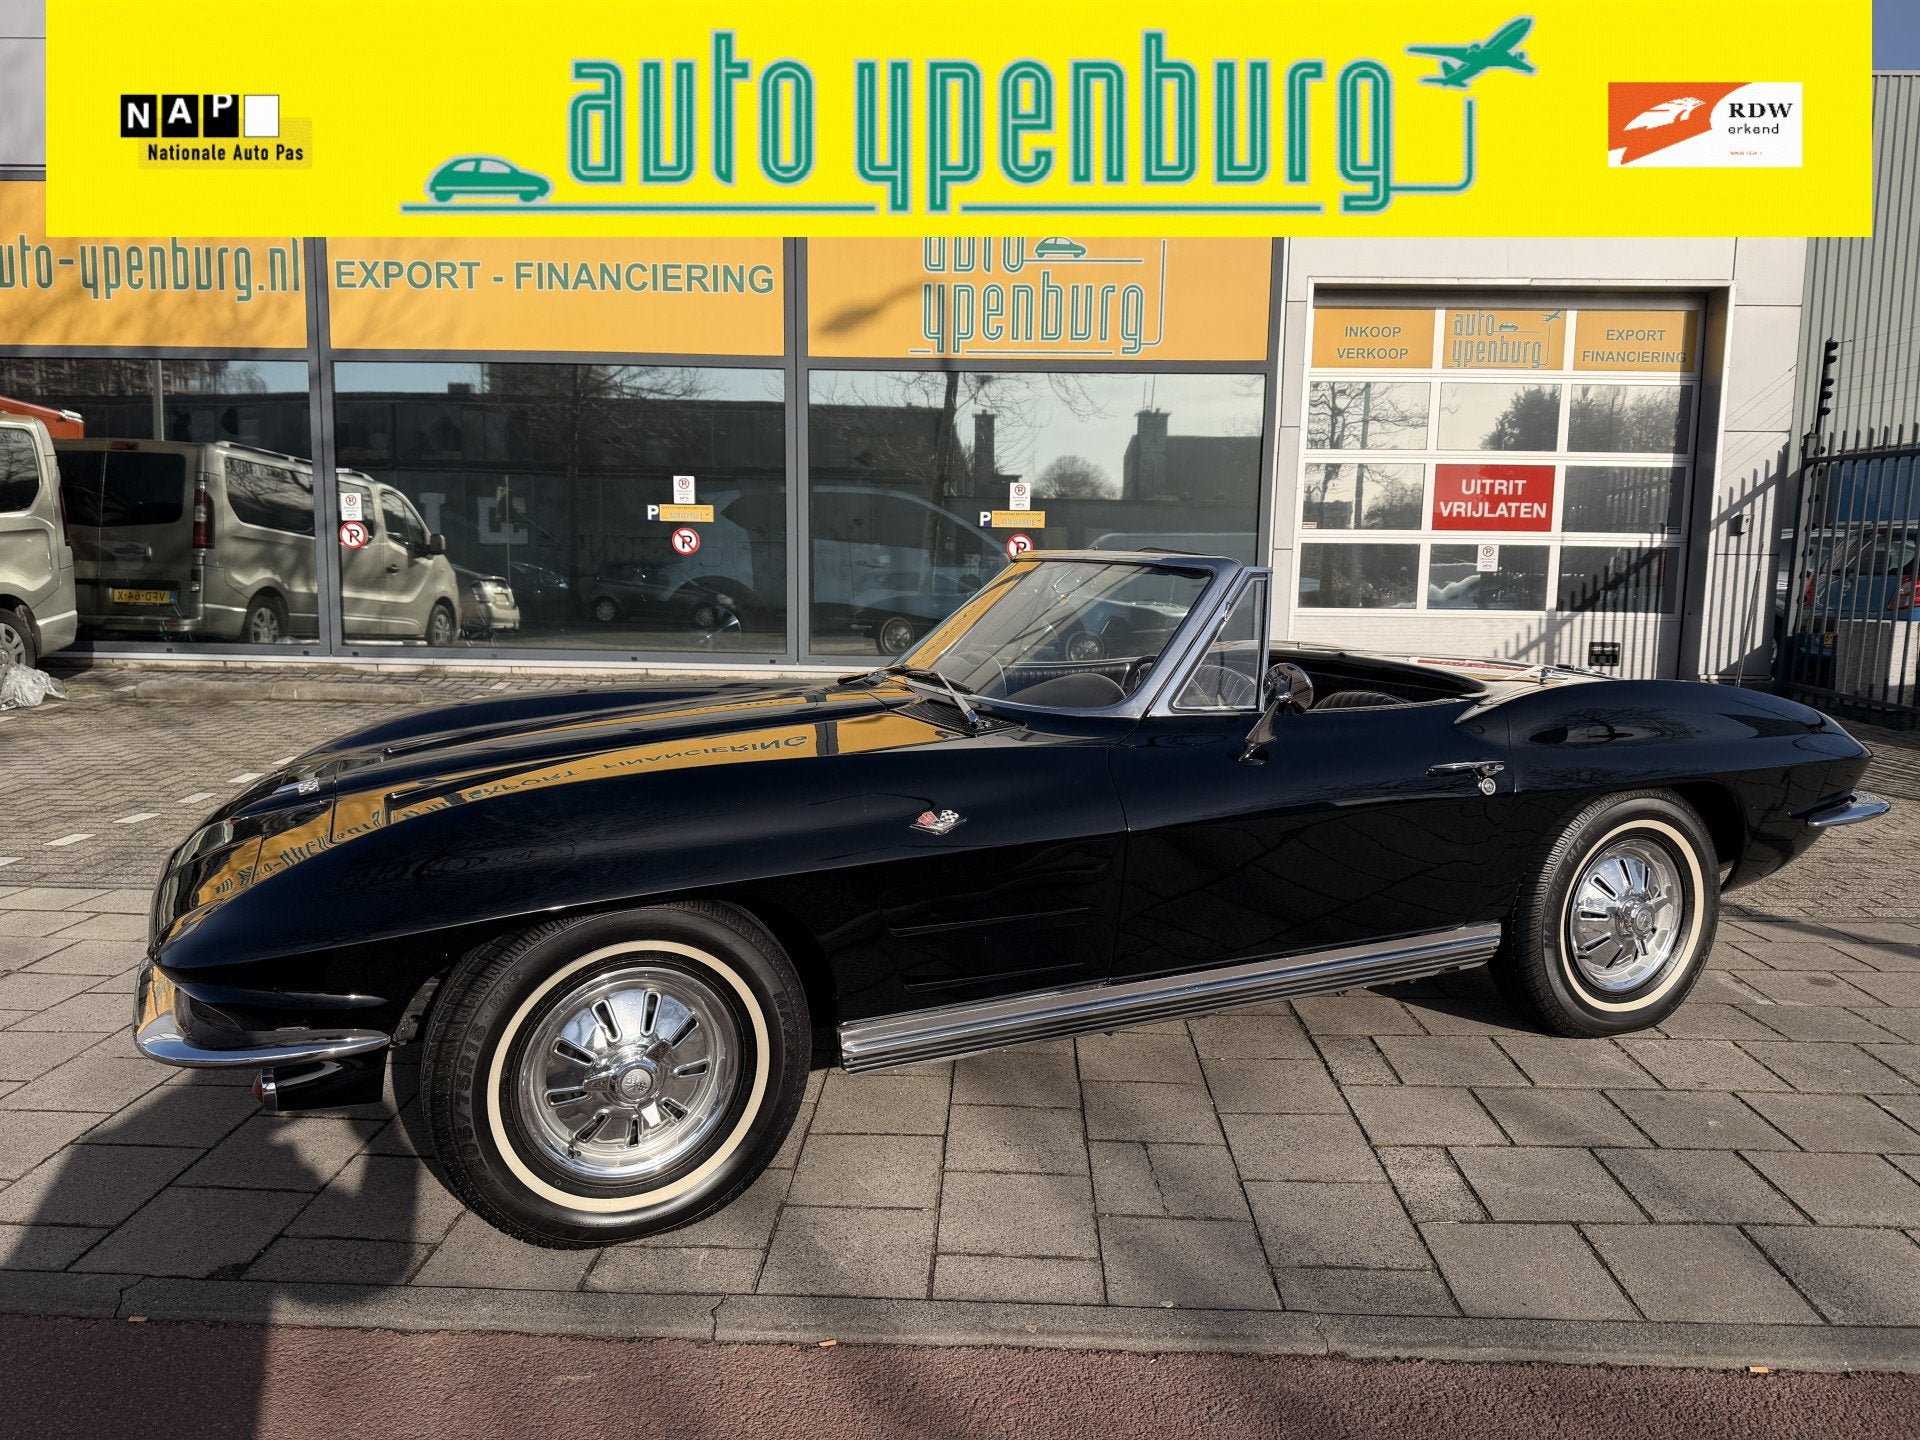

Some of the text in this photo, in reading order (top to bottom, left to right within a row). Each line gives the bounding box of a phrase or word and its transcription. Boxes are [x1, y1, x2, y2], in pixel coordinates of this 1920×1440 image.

[0, 234, 300, 302] uto-ypenburg.nl
[335, 260, 481, 290] EXPORT
[514, 261, 775, 294] FINANCIERING
[923, 270, 1144, 355] ypenburg
[1453, 309, 1495, 336] auto
[1344, 326, 1402, 338] INKOOP
[1606, 329, 1666, 341] EXPORT
[1337, 347, 1409, 360] VERKOOP
[1452, 336, 1542, 368] ypenburg
[1582, 350, 1687, 363] FINANCIERING
[1461, 478, 1527, 496] UITRIT
[1439, 501, 1547, 518] VRIJLATEN
